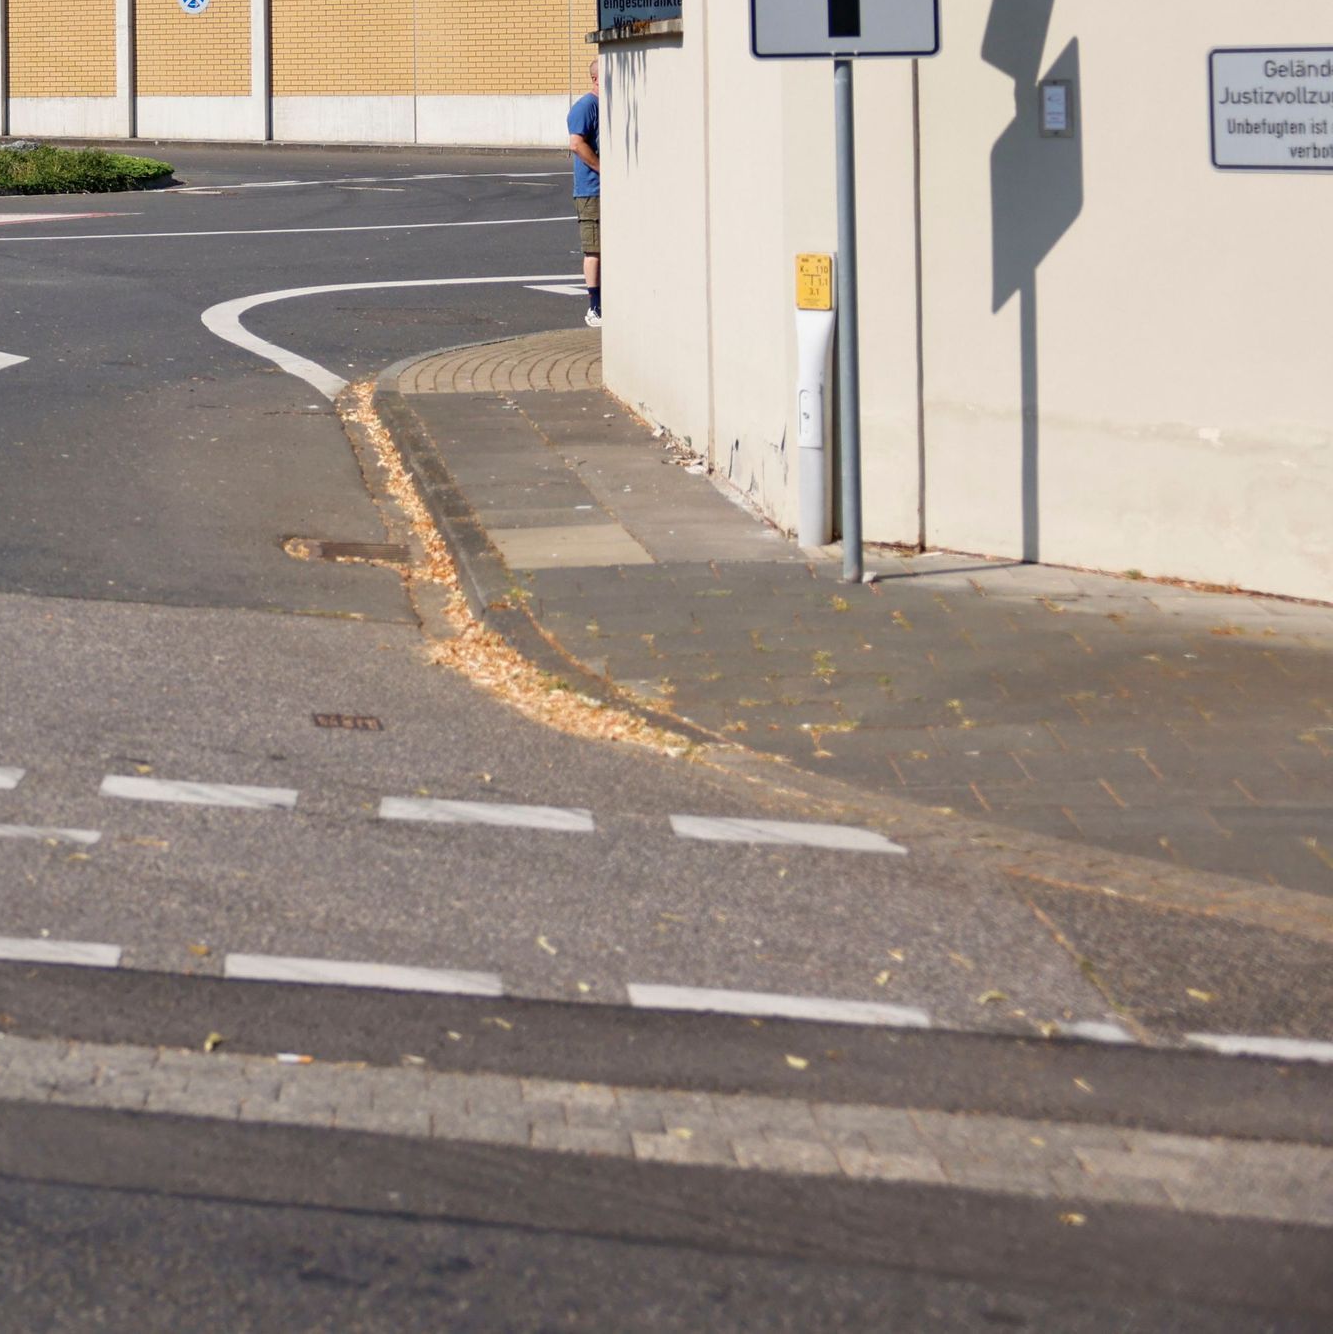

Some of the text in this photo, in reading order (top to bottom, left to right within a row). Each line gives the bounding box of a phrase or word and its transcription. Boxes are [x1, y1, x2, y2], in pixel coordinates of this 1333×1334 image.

[1264, 59, 1333, 78] Geländ
[1218, 86, 1333, 107] Justizvollzu
[1227, 118, 1327, 138] Unbefugten ist
